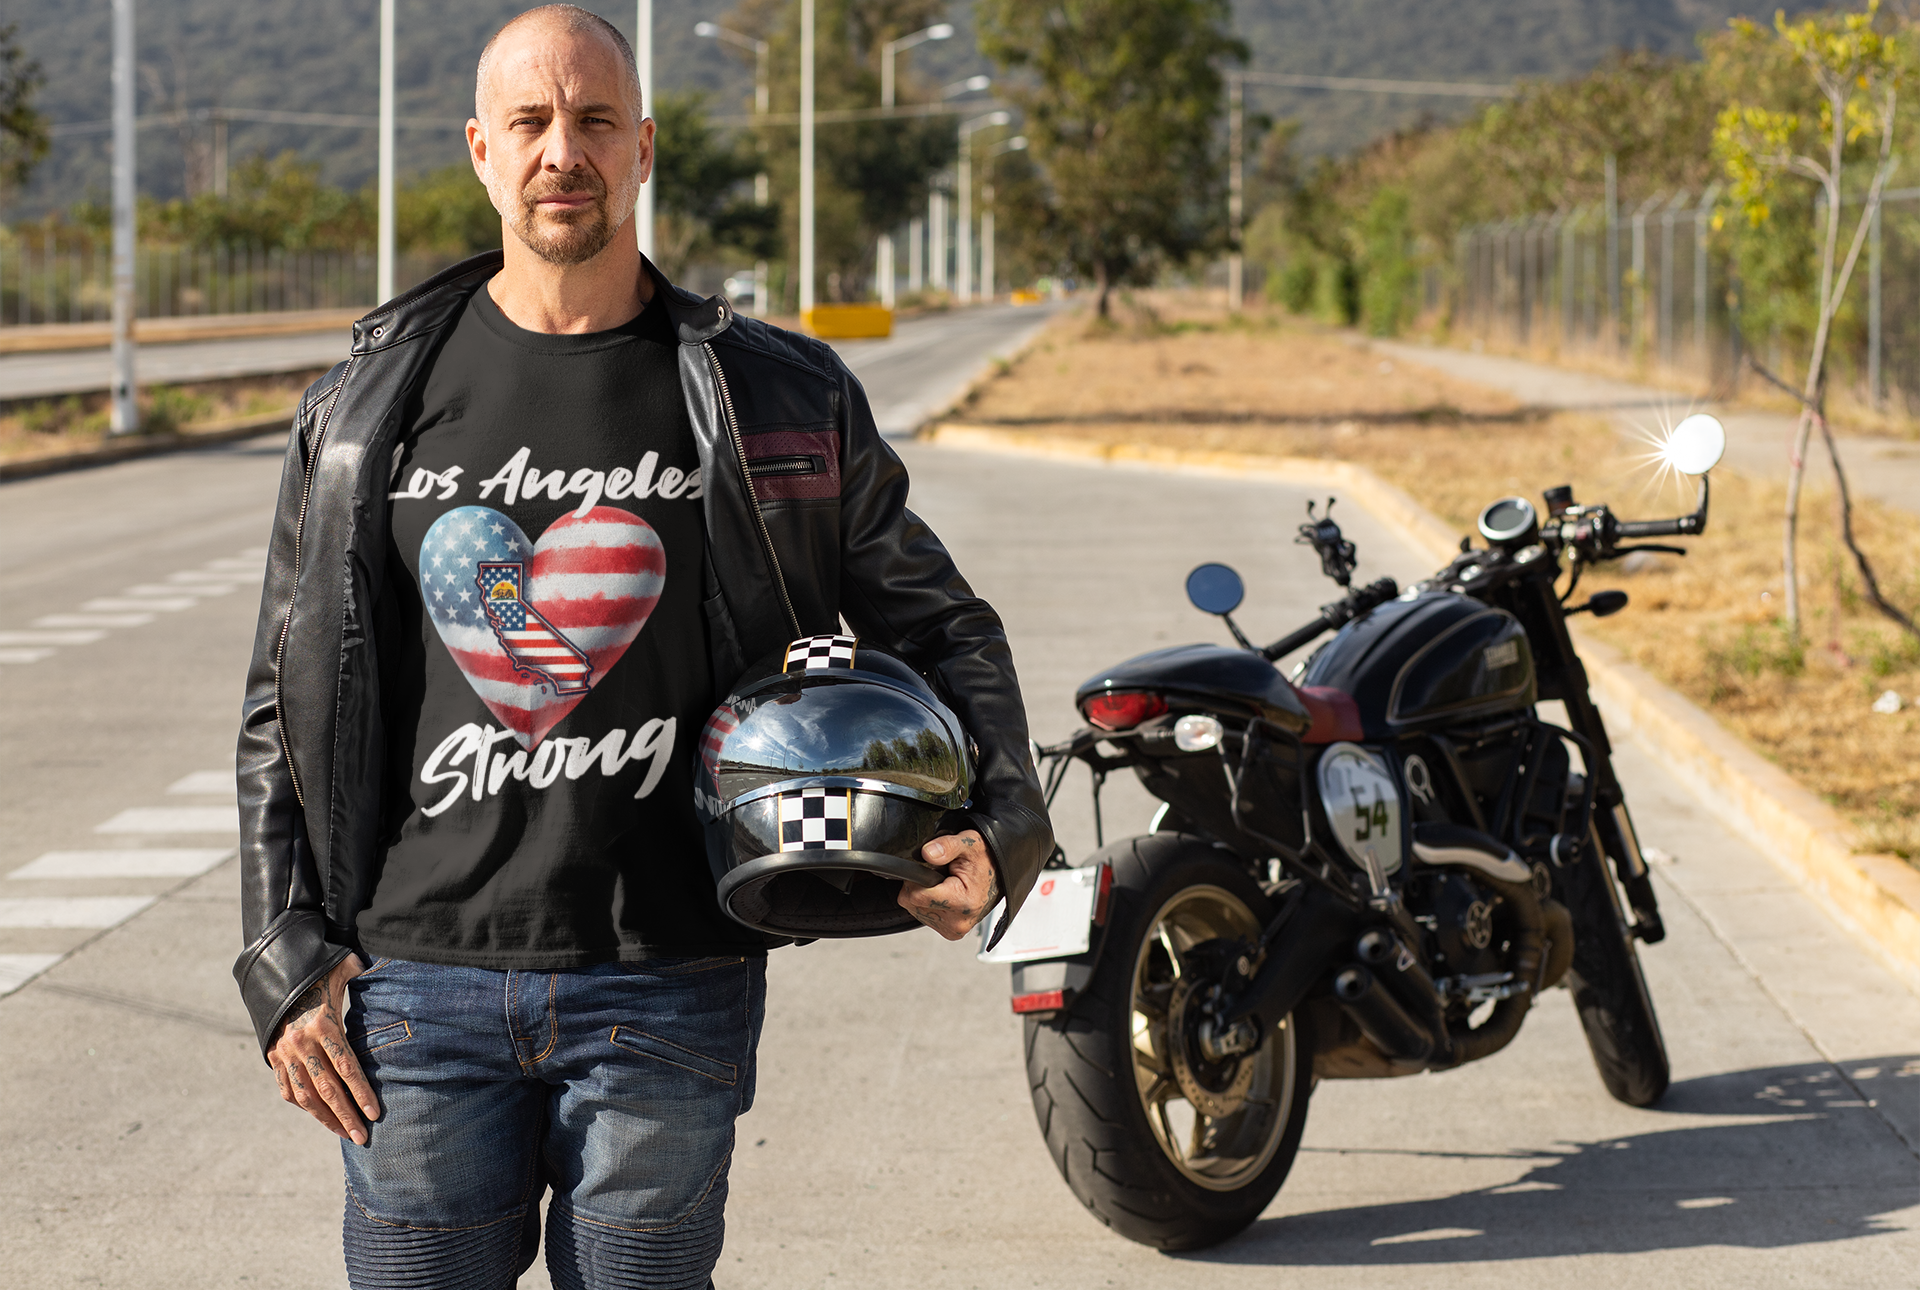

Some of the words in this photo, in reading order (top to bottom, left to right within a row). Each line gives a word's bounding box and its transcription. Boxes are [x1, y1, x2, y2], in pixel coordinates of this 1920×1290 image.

[388, 442, 464, 500] Los
[479, 446, 703, 519] Angeles
[420, 716, 677, 817] Strong
[1351, 782, 1388, 842] 54
